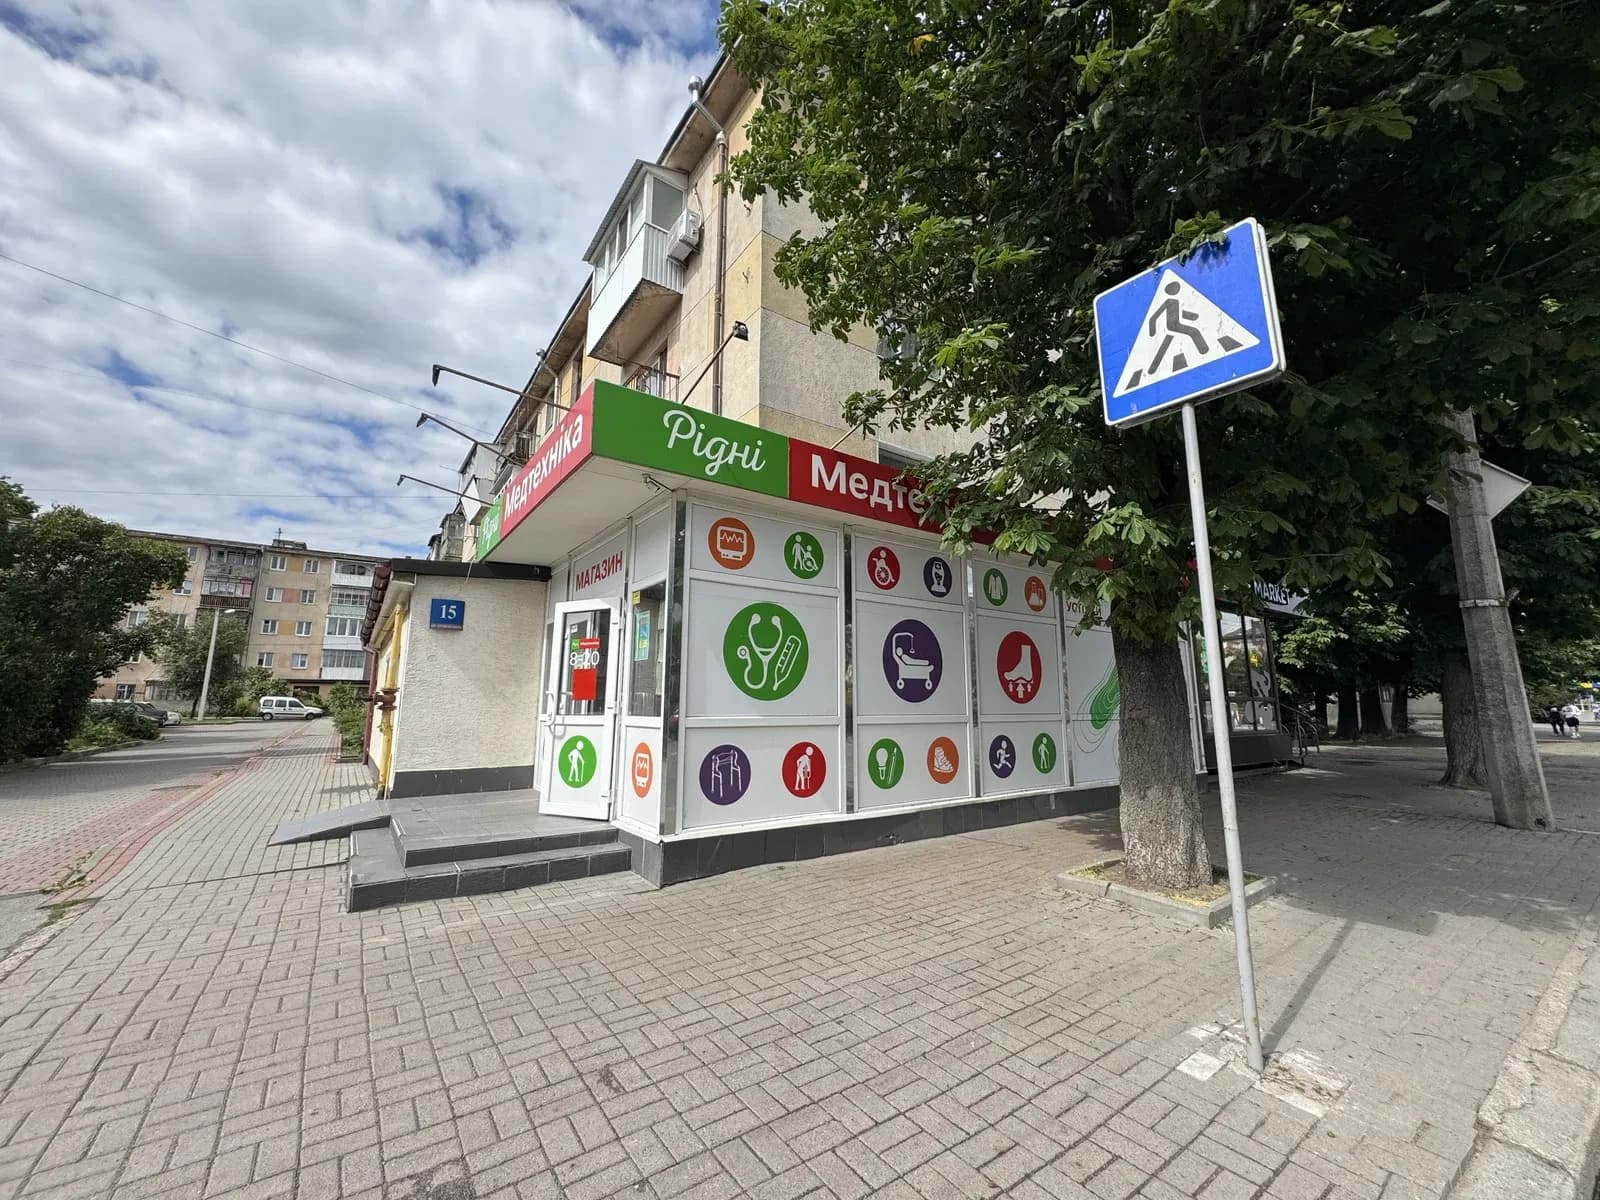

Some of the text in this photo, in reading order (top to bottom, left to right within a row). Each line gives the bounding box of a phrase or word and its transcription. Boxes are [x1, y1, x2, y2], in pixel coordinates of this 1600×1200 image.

[504, 413, 583, 520] Медтехніка
[663, 409, 940, 514] Рідні Медте
[575, 551, 624, 592] МАГАЗИН
[439, 604, 457, 620] 15
[1253, 580, 1290, 606] MARKET
